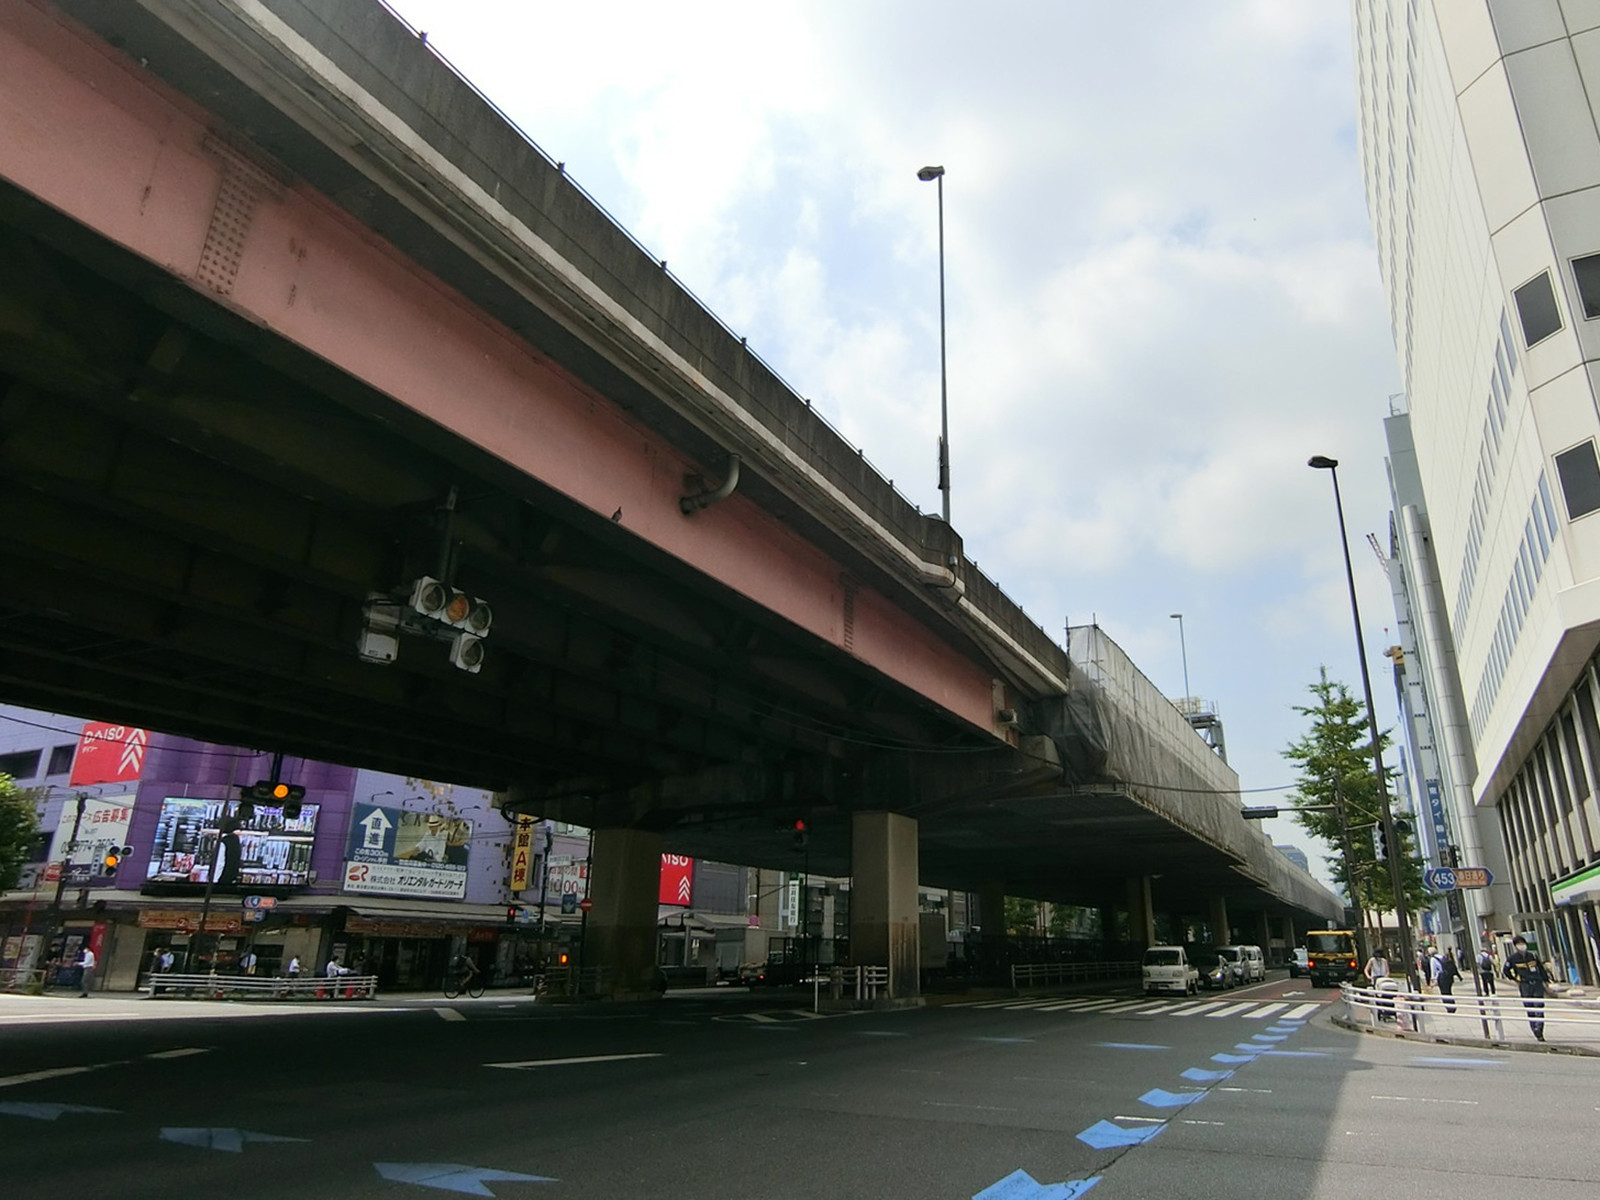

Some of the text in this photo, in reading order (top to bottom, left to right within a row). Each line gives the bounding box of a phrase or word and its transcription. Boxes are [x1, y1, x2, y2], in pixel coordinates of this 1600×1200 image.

[84, 726, 125, 744] DAISO
[92, 807, 129, 824] 広告募集
[369, 817, 382, 845] 直進
[513, 816, 532, 884] 本館A棟
[662, 853, 689, 866] ISO
[370, 875, 396, 885] 株式会社
[1434, 872, 1455, 885] 453
